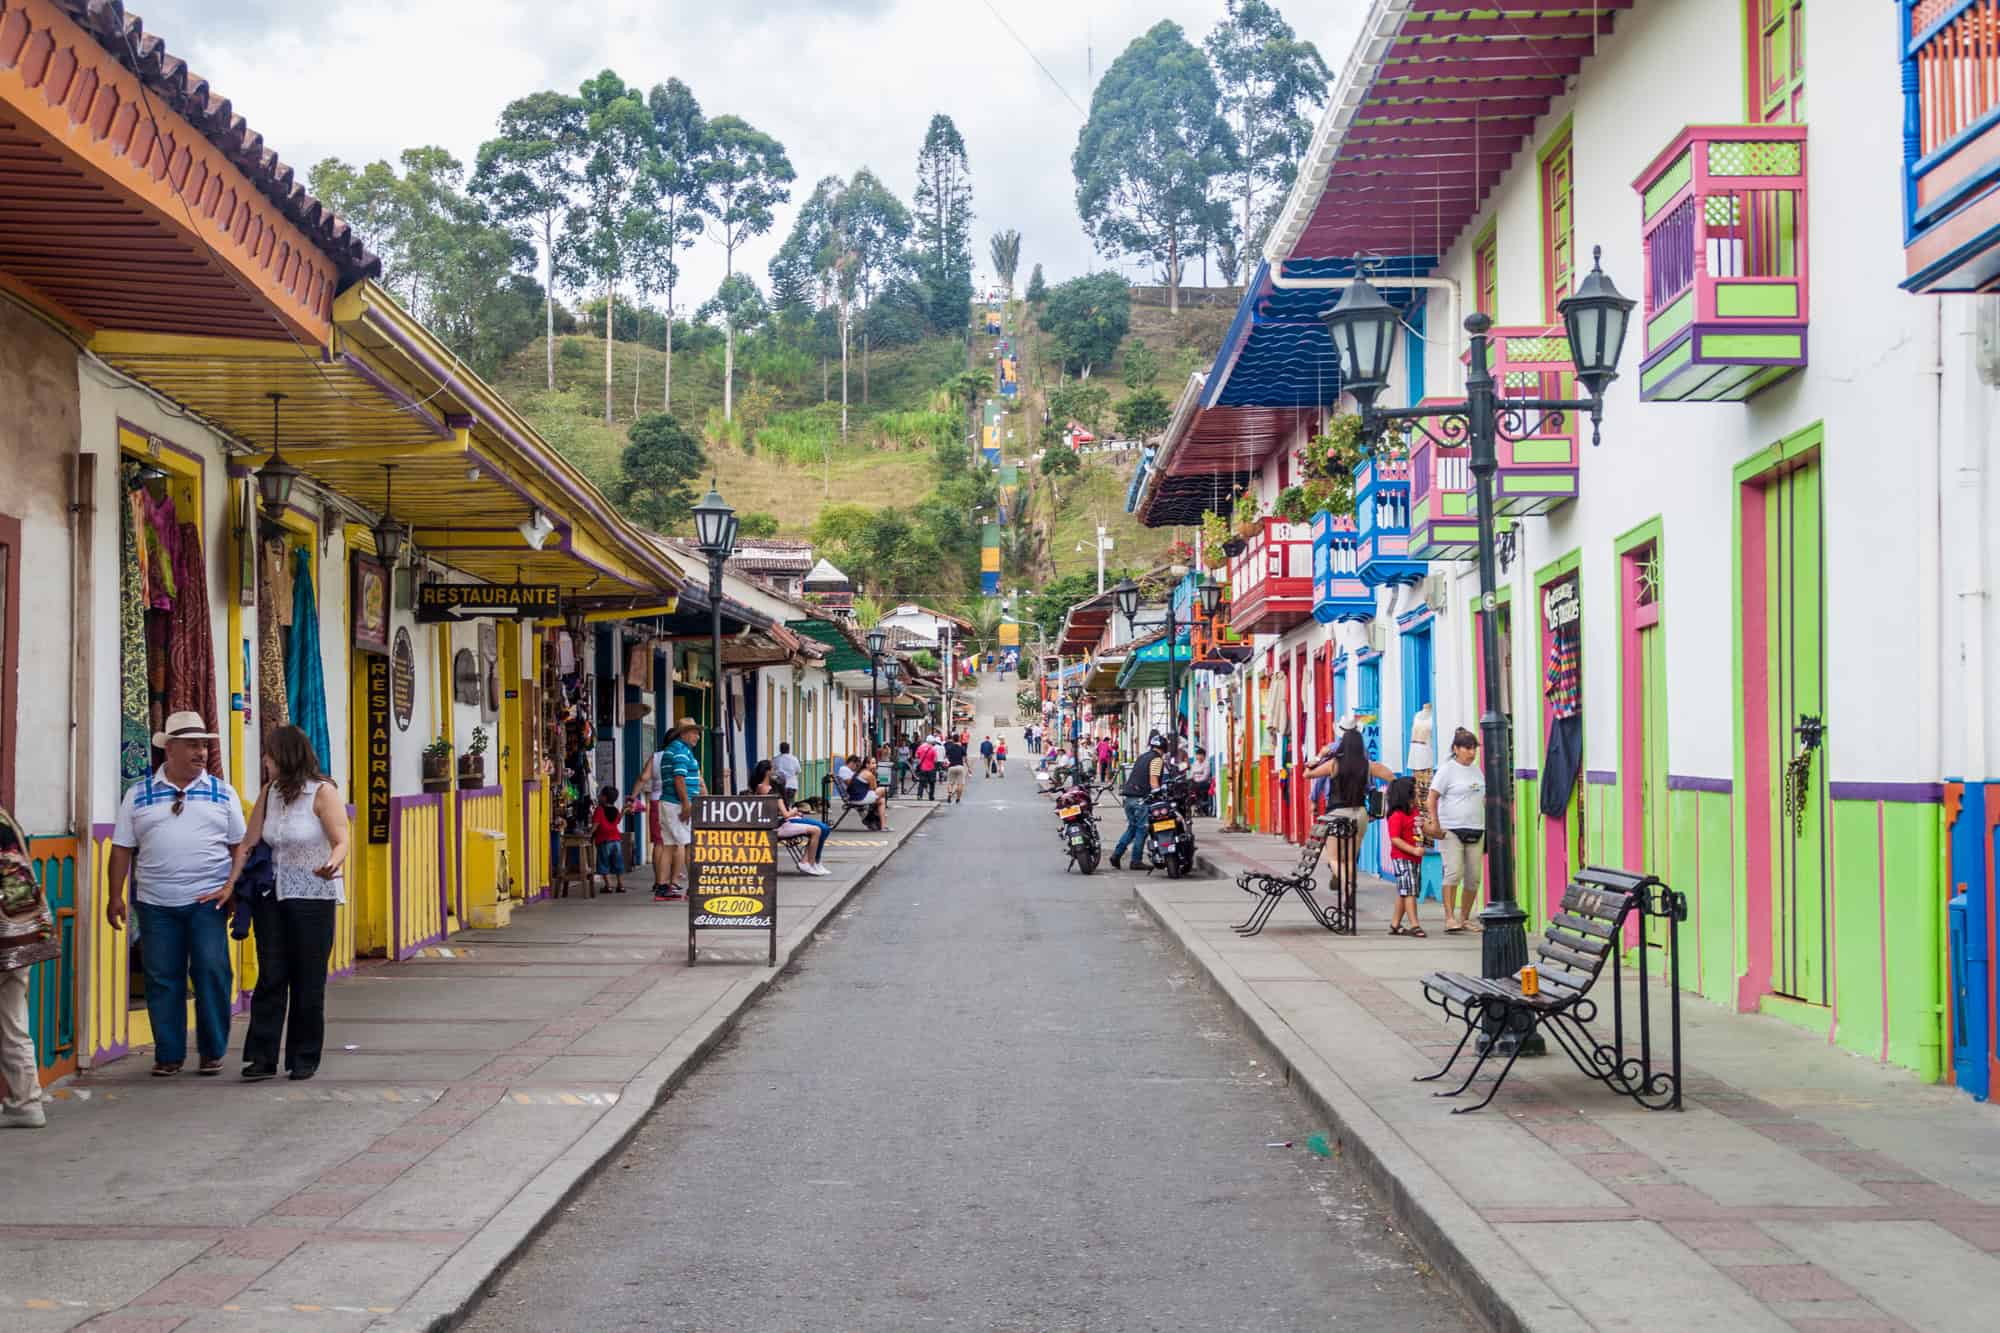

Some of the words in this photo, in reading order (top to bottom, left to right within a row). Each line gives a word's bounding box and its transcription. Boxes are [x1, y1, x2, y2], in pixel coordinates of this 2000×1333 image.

[423, 588, 557, 604] RESTAURANTE
[371, 664, 387, 838] RESTAURANTE
[694, 830, 771, 847] TRUCHA
[694, 847, 774, 864] DORADA
[702, 865, 758, 875] PATACON
[698, 876, 755, 886] GIGANTE
[757, 876, 765, 886] Y
[698, 886, 765, 896] ENSALADA
[693, 914, 773, 927] Bienvenidos
